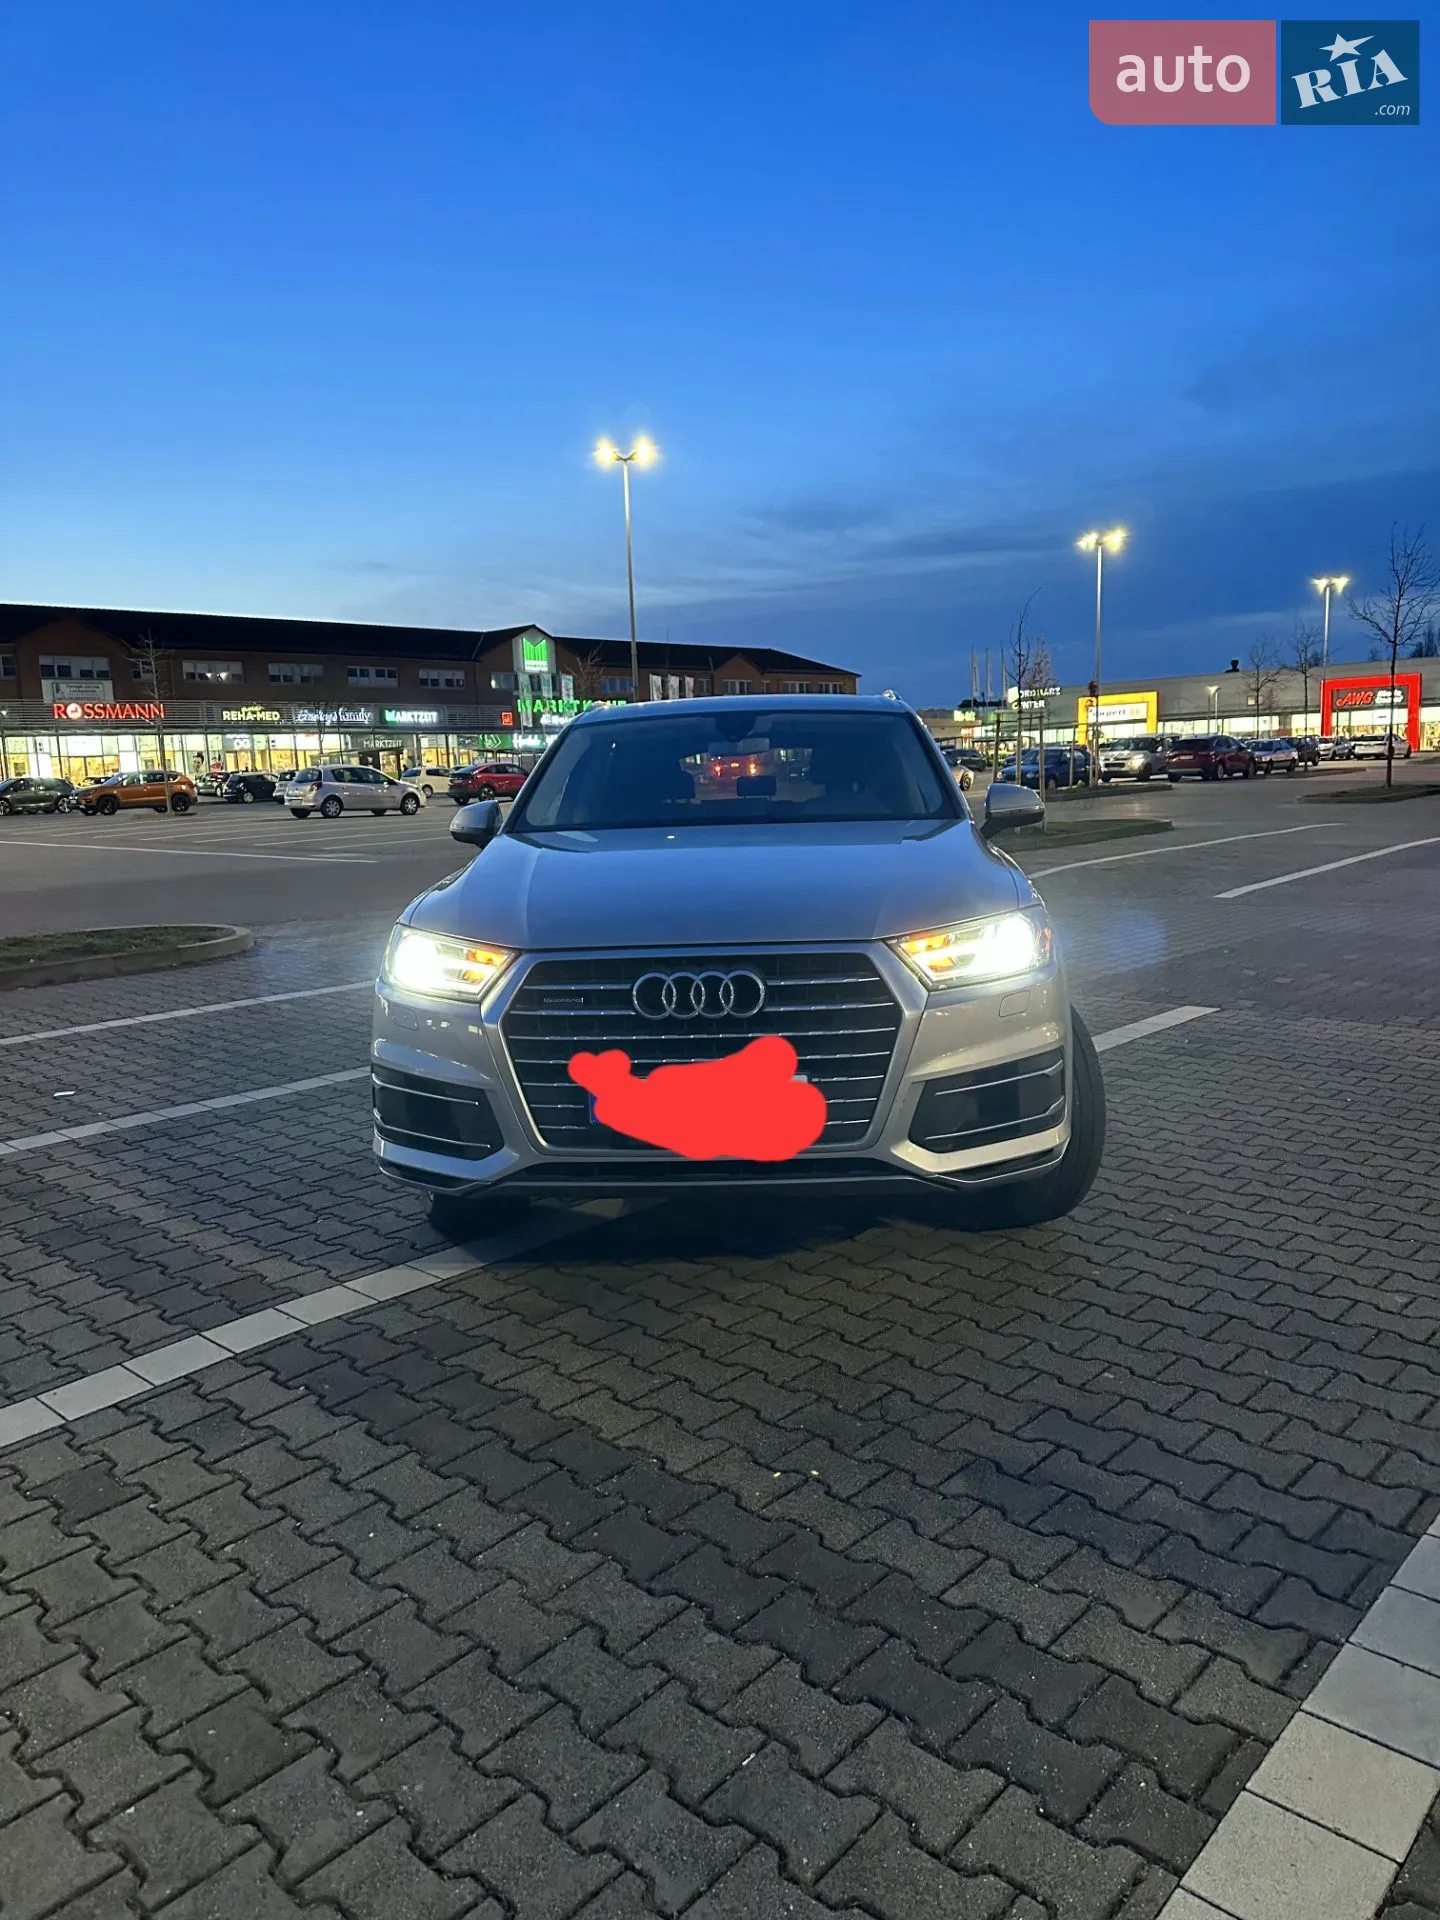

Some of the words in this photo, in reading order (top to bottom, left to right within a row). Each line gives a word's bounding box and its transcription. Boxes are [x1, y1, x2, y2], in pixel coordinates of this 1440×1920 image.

[53, 703, 165, 720] ROSSMANN
[384, 709, 439, 723] MARKTZEIT
[363, 738, 403, 749] MARKTZEIT
